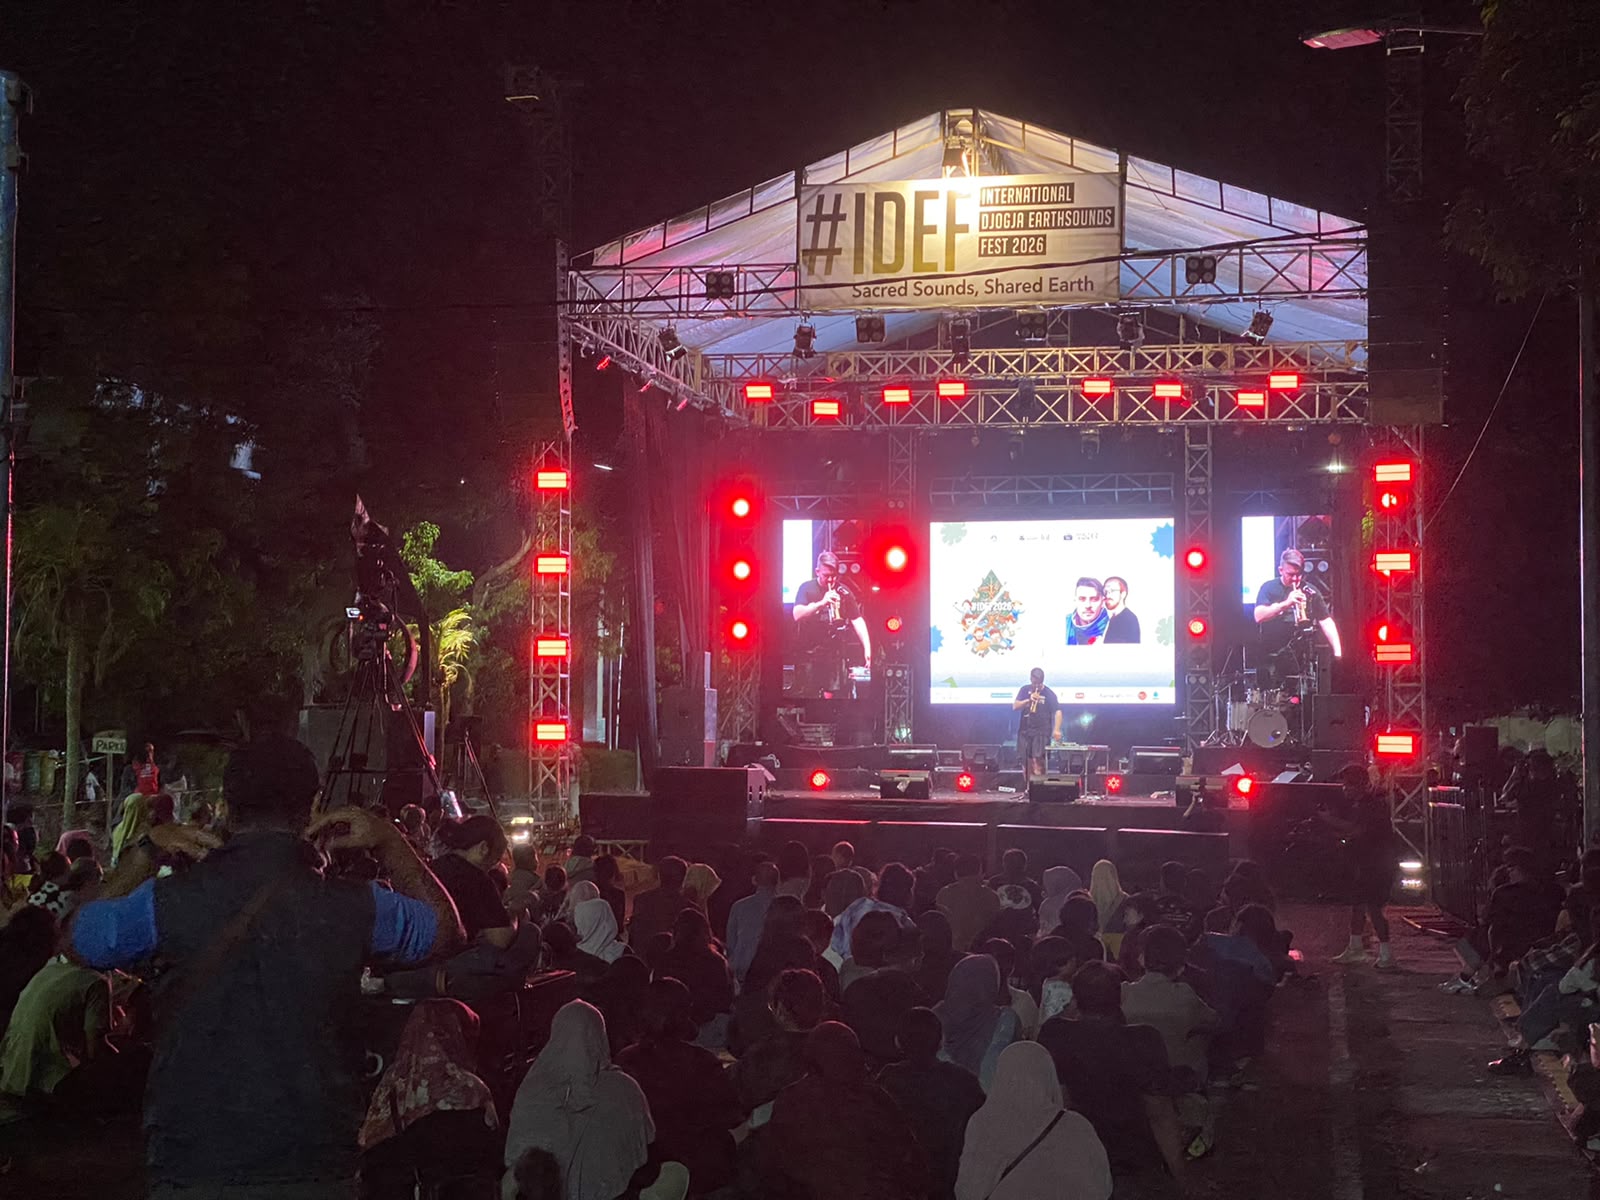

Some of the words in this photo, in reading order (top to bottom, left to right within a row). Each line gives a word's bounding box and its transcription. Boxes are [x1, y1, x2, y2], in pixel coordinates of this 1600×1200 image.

[981, 185, 1072, 205] INTERNATIONAL
[981, 211, 1024, 230] DJOGJA
[1028, 208, 1112, 228] EARTHSOUNDS
[802, 190, 971, 276] #IDEF
[980, 238, 1009, 255] FEST
[1012, 236, 1044, 254] 2026
[852, 280, 908, 298] Sacred
[913, 279, 979, 298] Sounds,
[984, 276, 1043, 295] Shared
[1048, 276, 1094, 293] Earth
